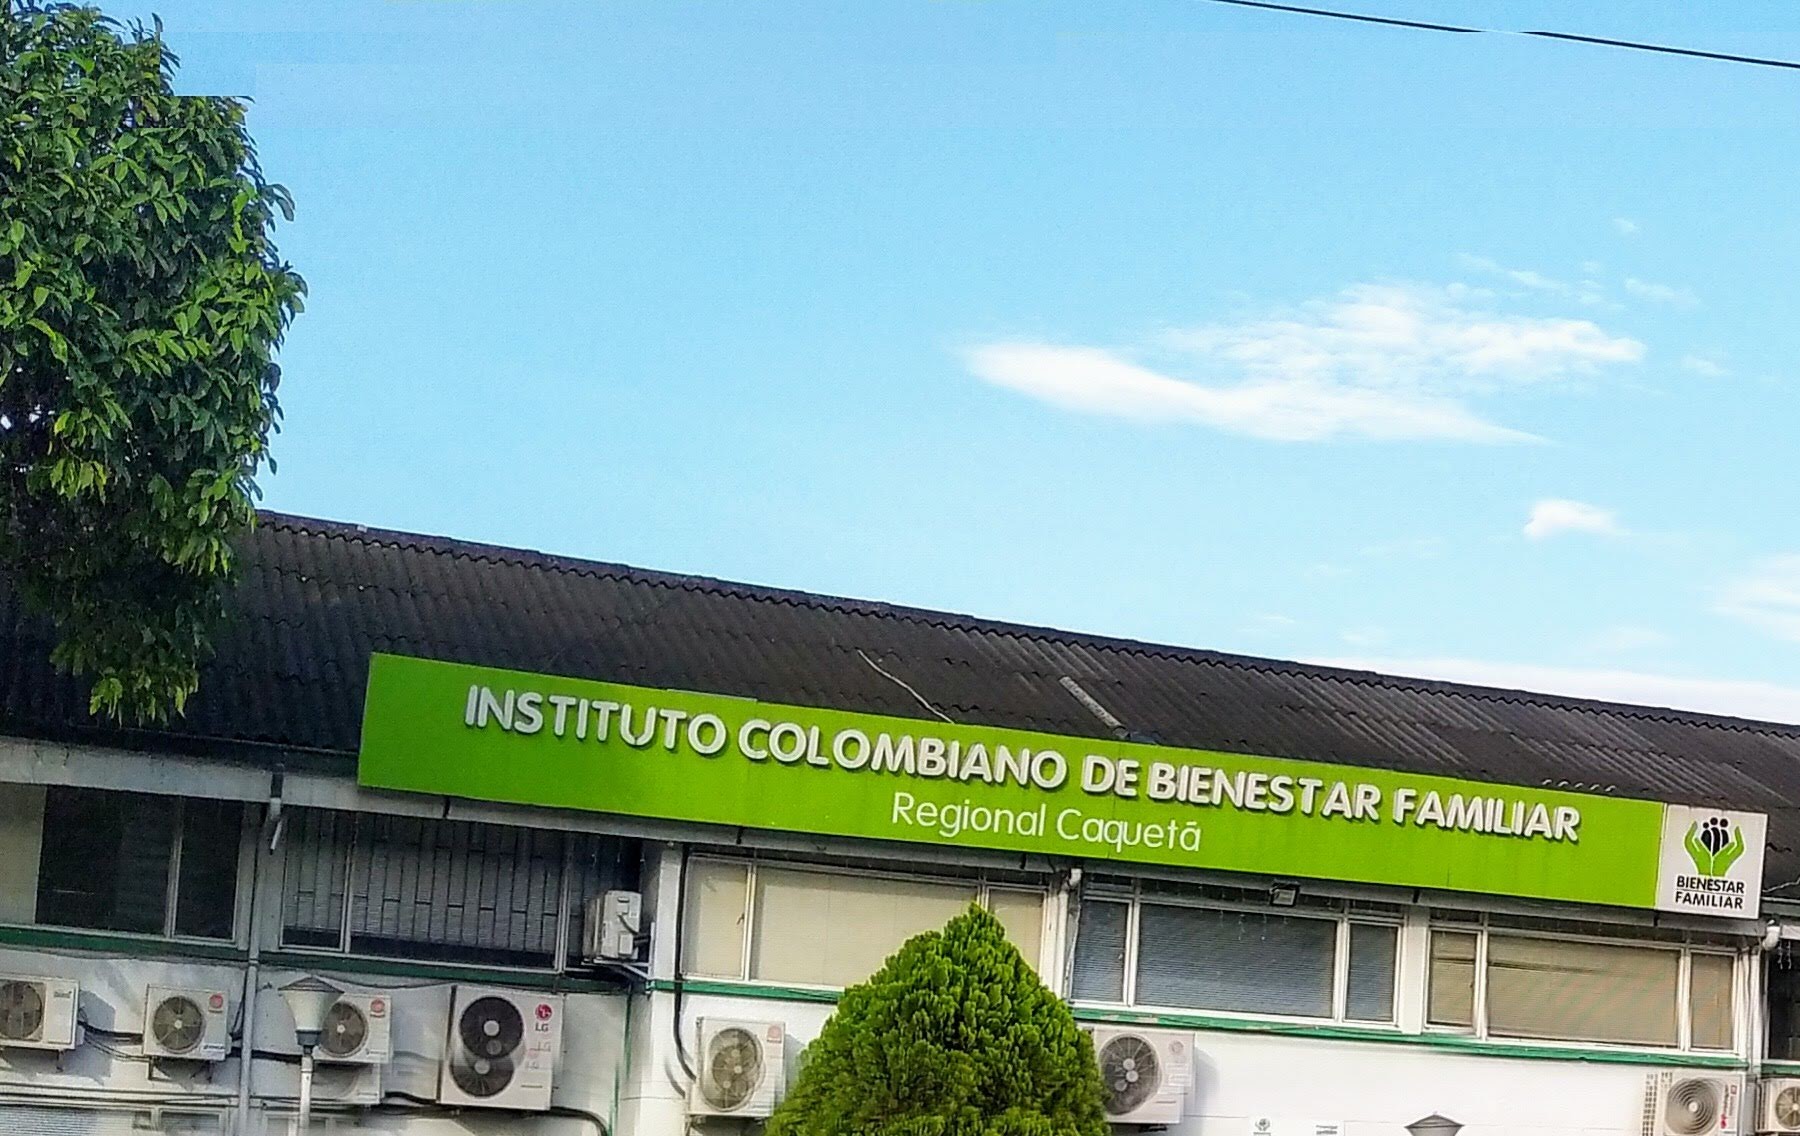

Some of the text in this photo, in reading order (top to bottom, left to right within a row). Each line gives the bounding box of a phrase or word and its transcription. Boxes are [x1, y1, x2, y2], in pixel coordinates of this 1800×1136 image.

[465, 685, 1580, 841] INSTITUTO COLOMBIANO DE BIENESTAR FAMILIAR
[892, 792, 1201, 853] Regional Caquetá
[1675, 891, 1743, 909] FAMILIAR
[1676, 875, 1745, 894] BIENESTAR
